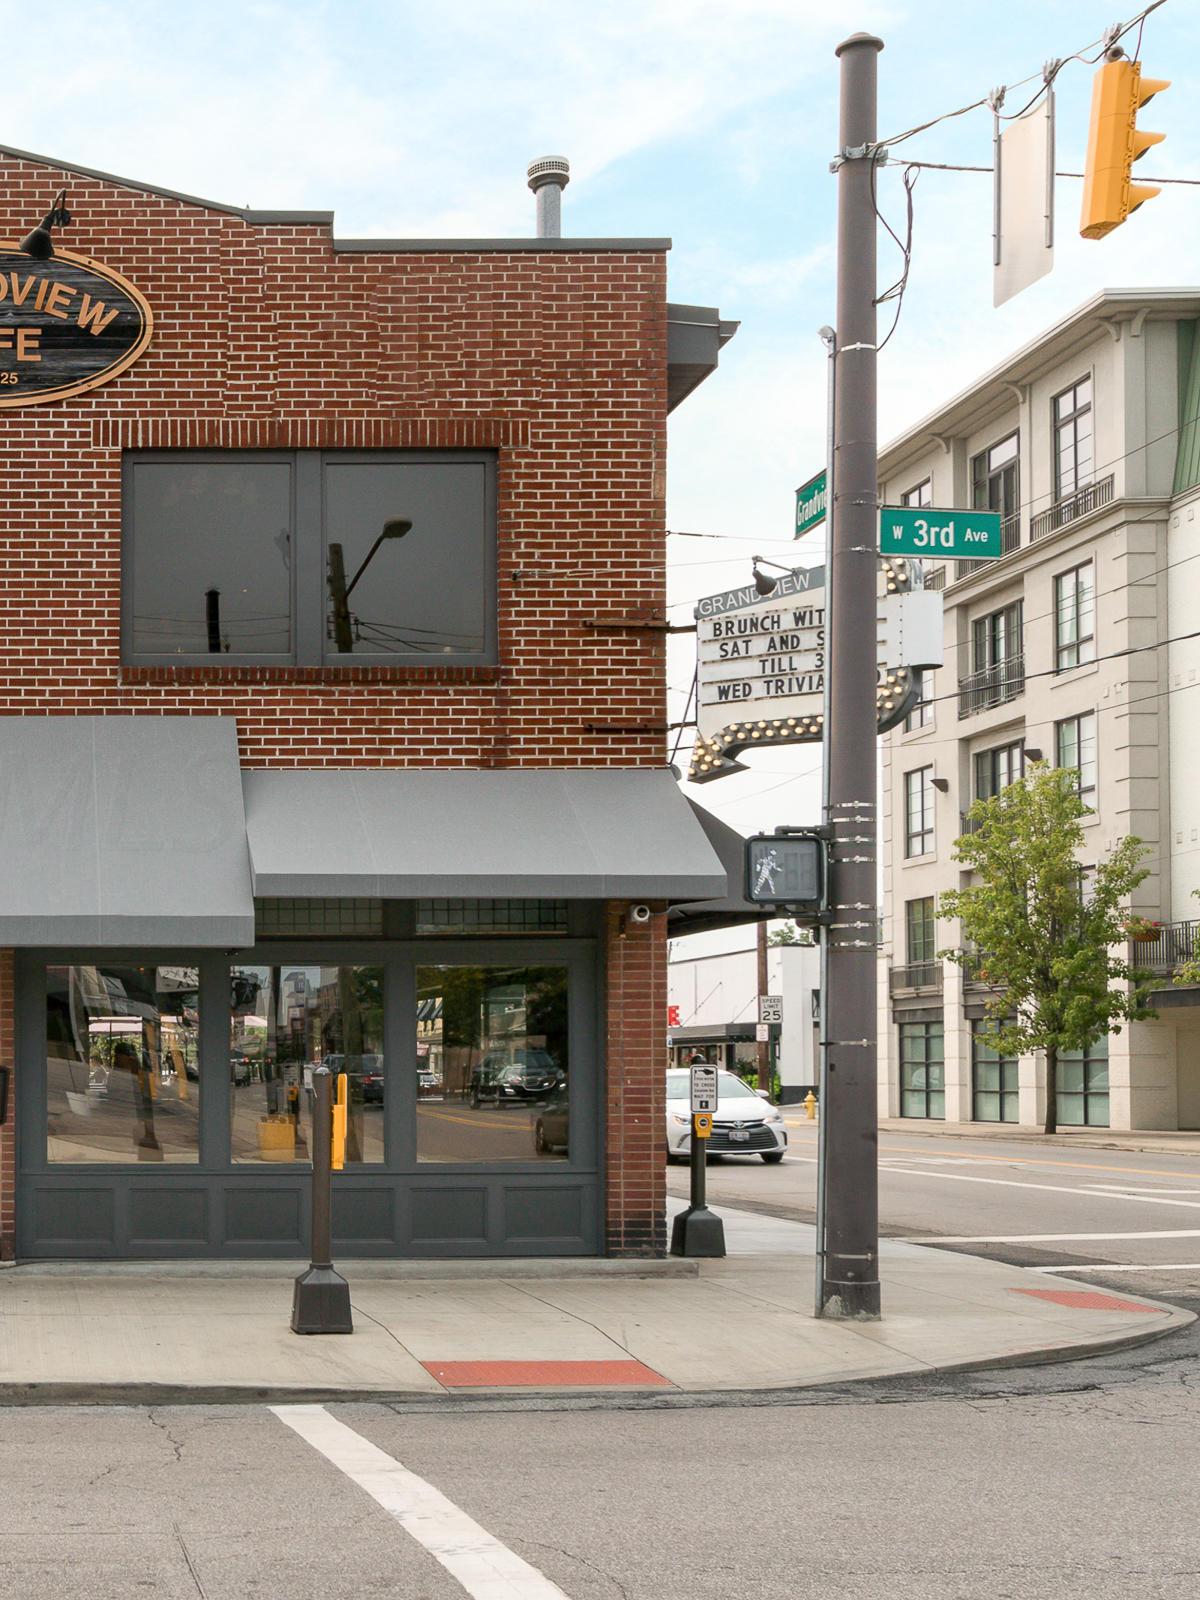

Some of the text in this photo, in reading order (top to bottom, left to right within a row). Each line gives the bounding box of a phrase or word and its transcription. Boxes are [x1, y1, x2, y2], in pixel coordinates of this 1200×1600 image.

[892, 519, 989, 547] W 3rd Ave
[713, 614, 781, 638] BRUNCH
[719, 639, 752, 658] SAT
[767, 634, 800, 652] AND
[759, 656, 798, 674] TILL
[718, 674, 824, 701] WED TRIVIA
[762, 1010, 782, 1021] 25
